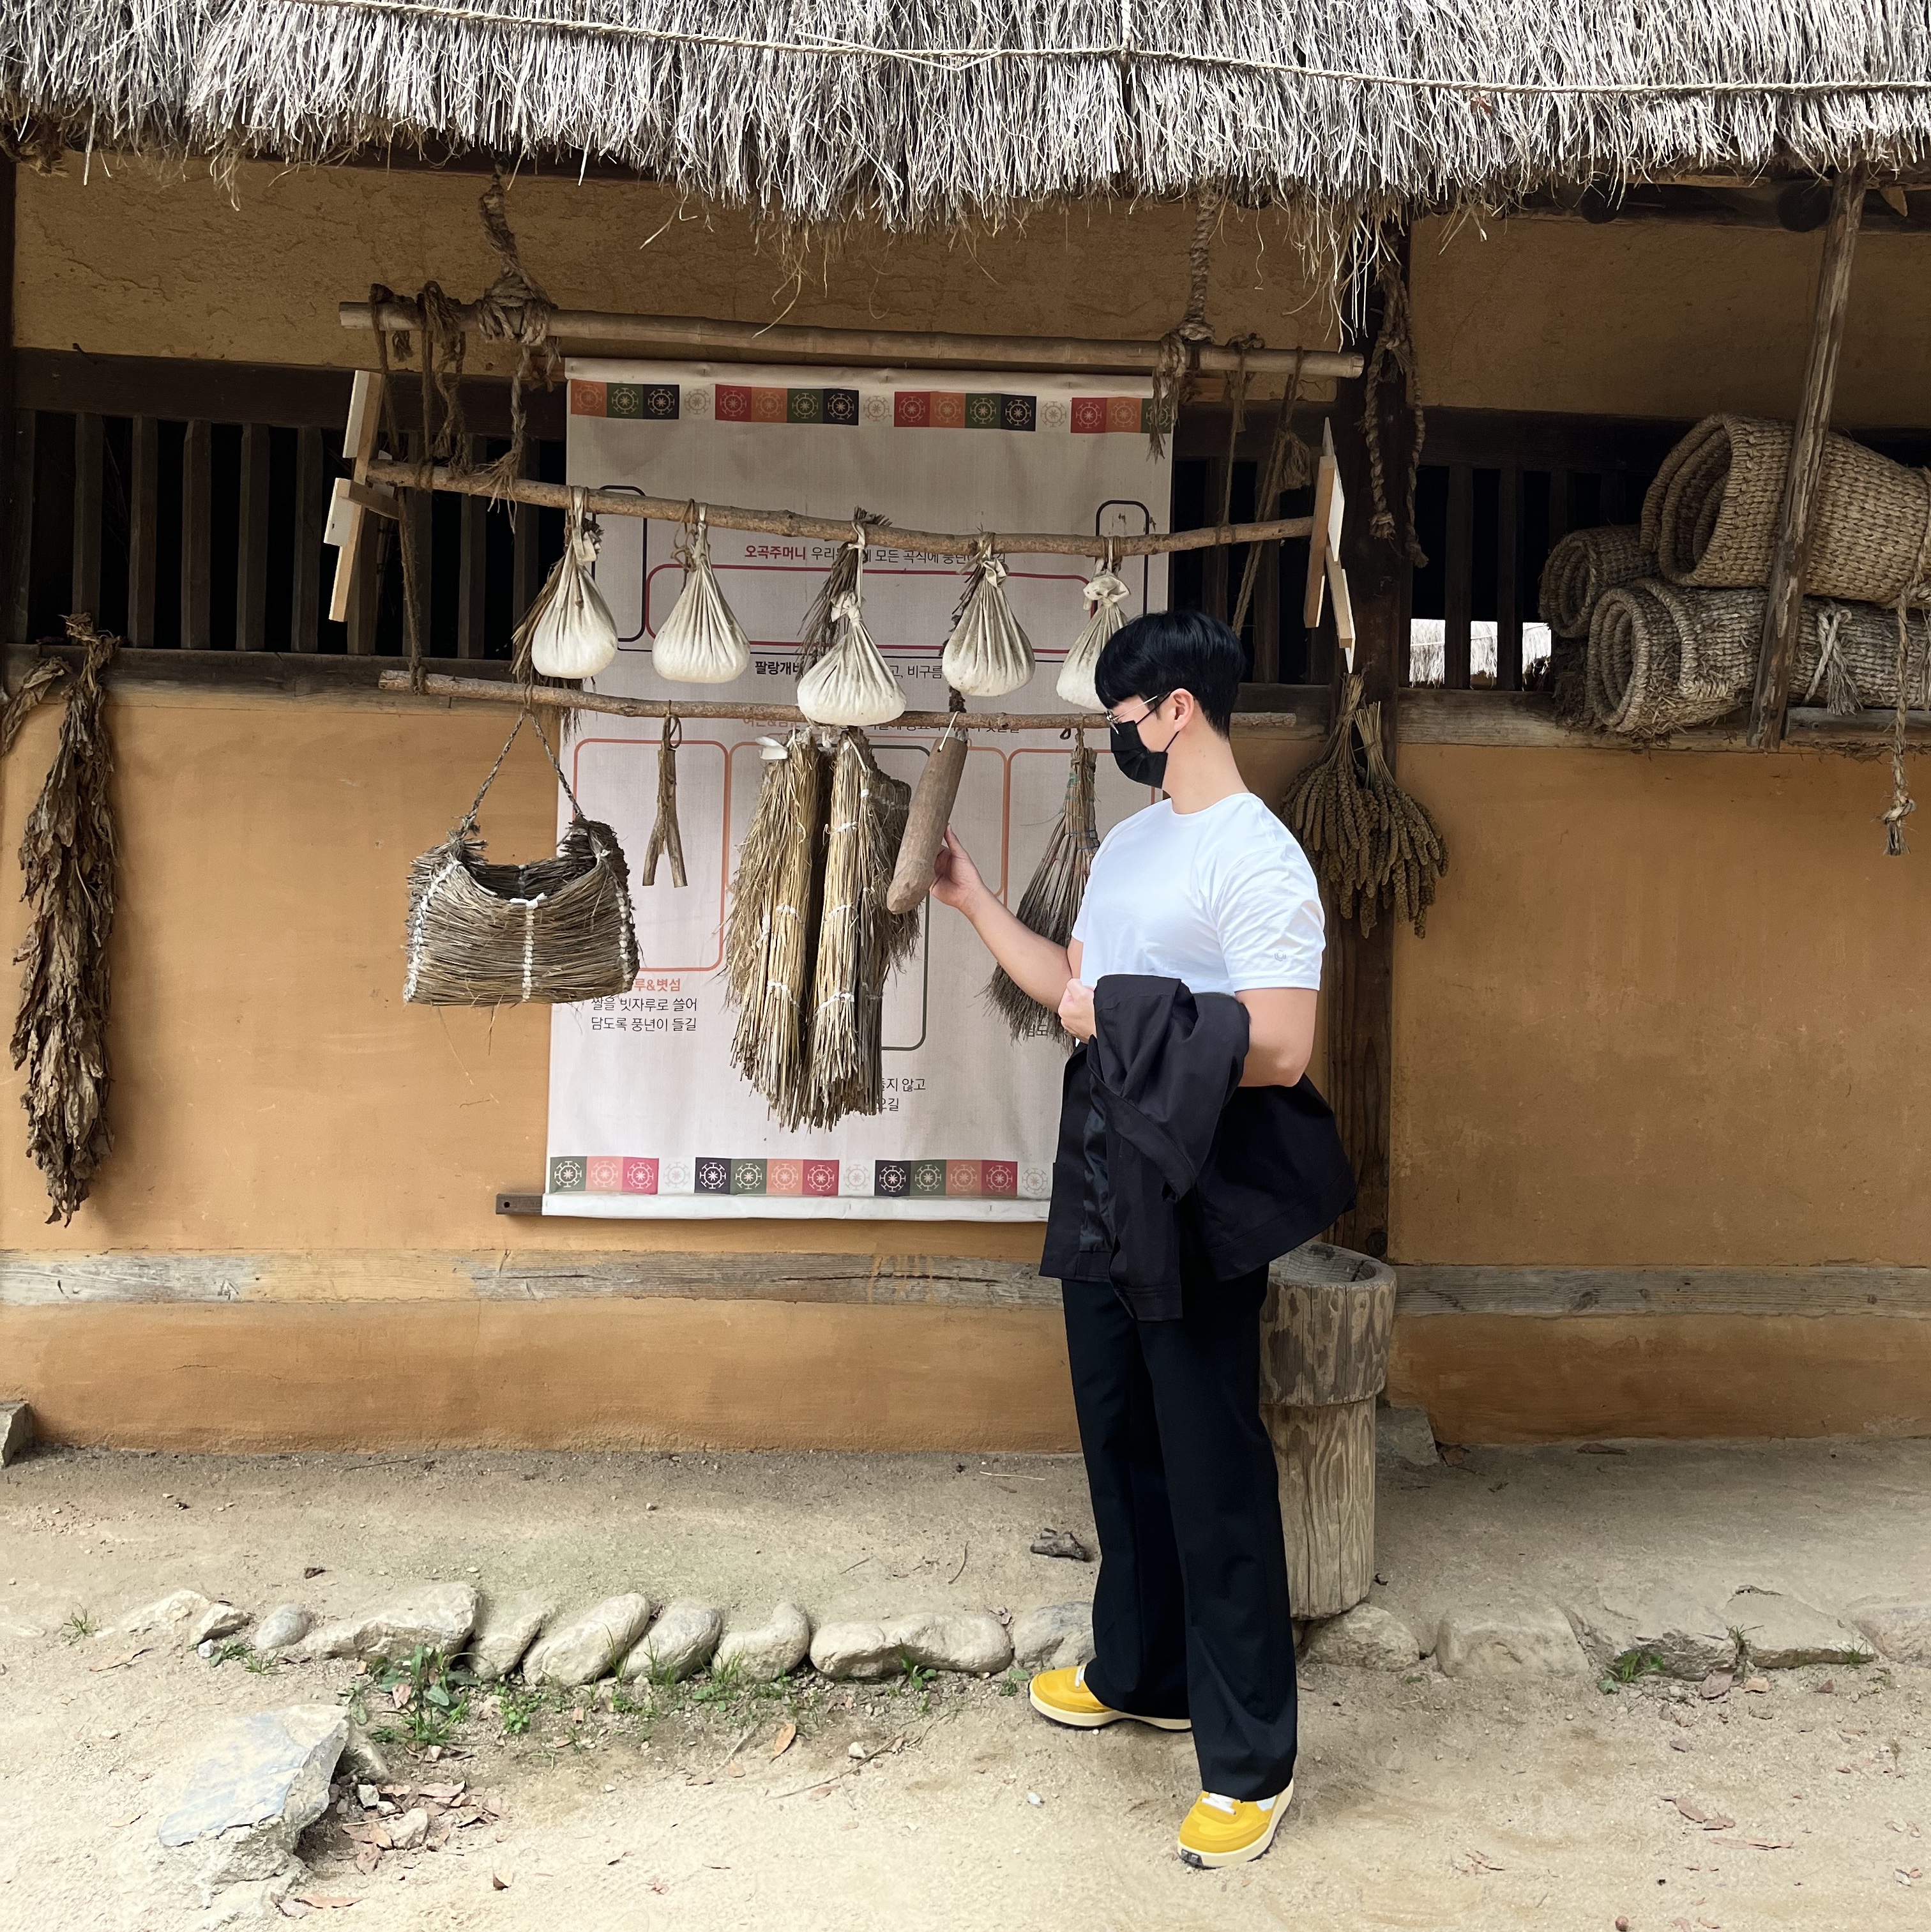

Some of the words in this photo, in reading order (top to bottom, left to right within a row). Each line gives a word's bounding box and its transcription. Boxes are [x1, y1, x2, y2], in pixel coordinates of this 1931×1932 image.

[745, 545, 806, 560] 오곡주머니
[875, 549, 899, 563] 모든
[902, 550, 939, 564] 곡식에
[890, 665, 903, 679] 고,
[633, 978, 680, 992] 루&볏섬
[591, 997, 616, 1011] 쌀을
[620, 998, 669, 1012] 빗자루로
[672, 998, 697, 1012] 쓸어
[591, 1017, 628, 1031] 담도록
[631, 1017, 668, 1031] 풍년이
[672, 1017, 697, 1031] 들길
[902, 1078, 926, 1092] 않고
